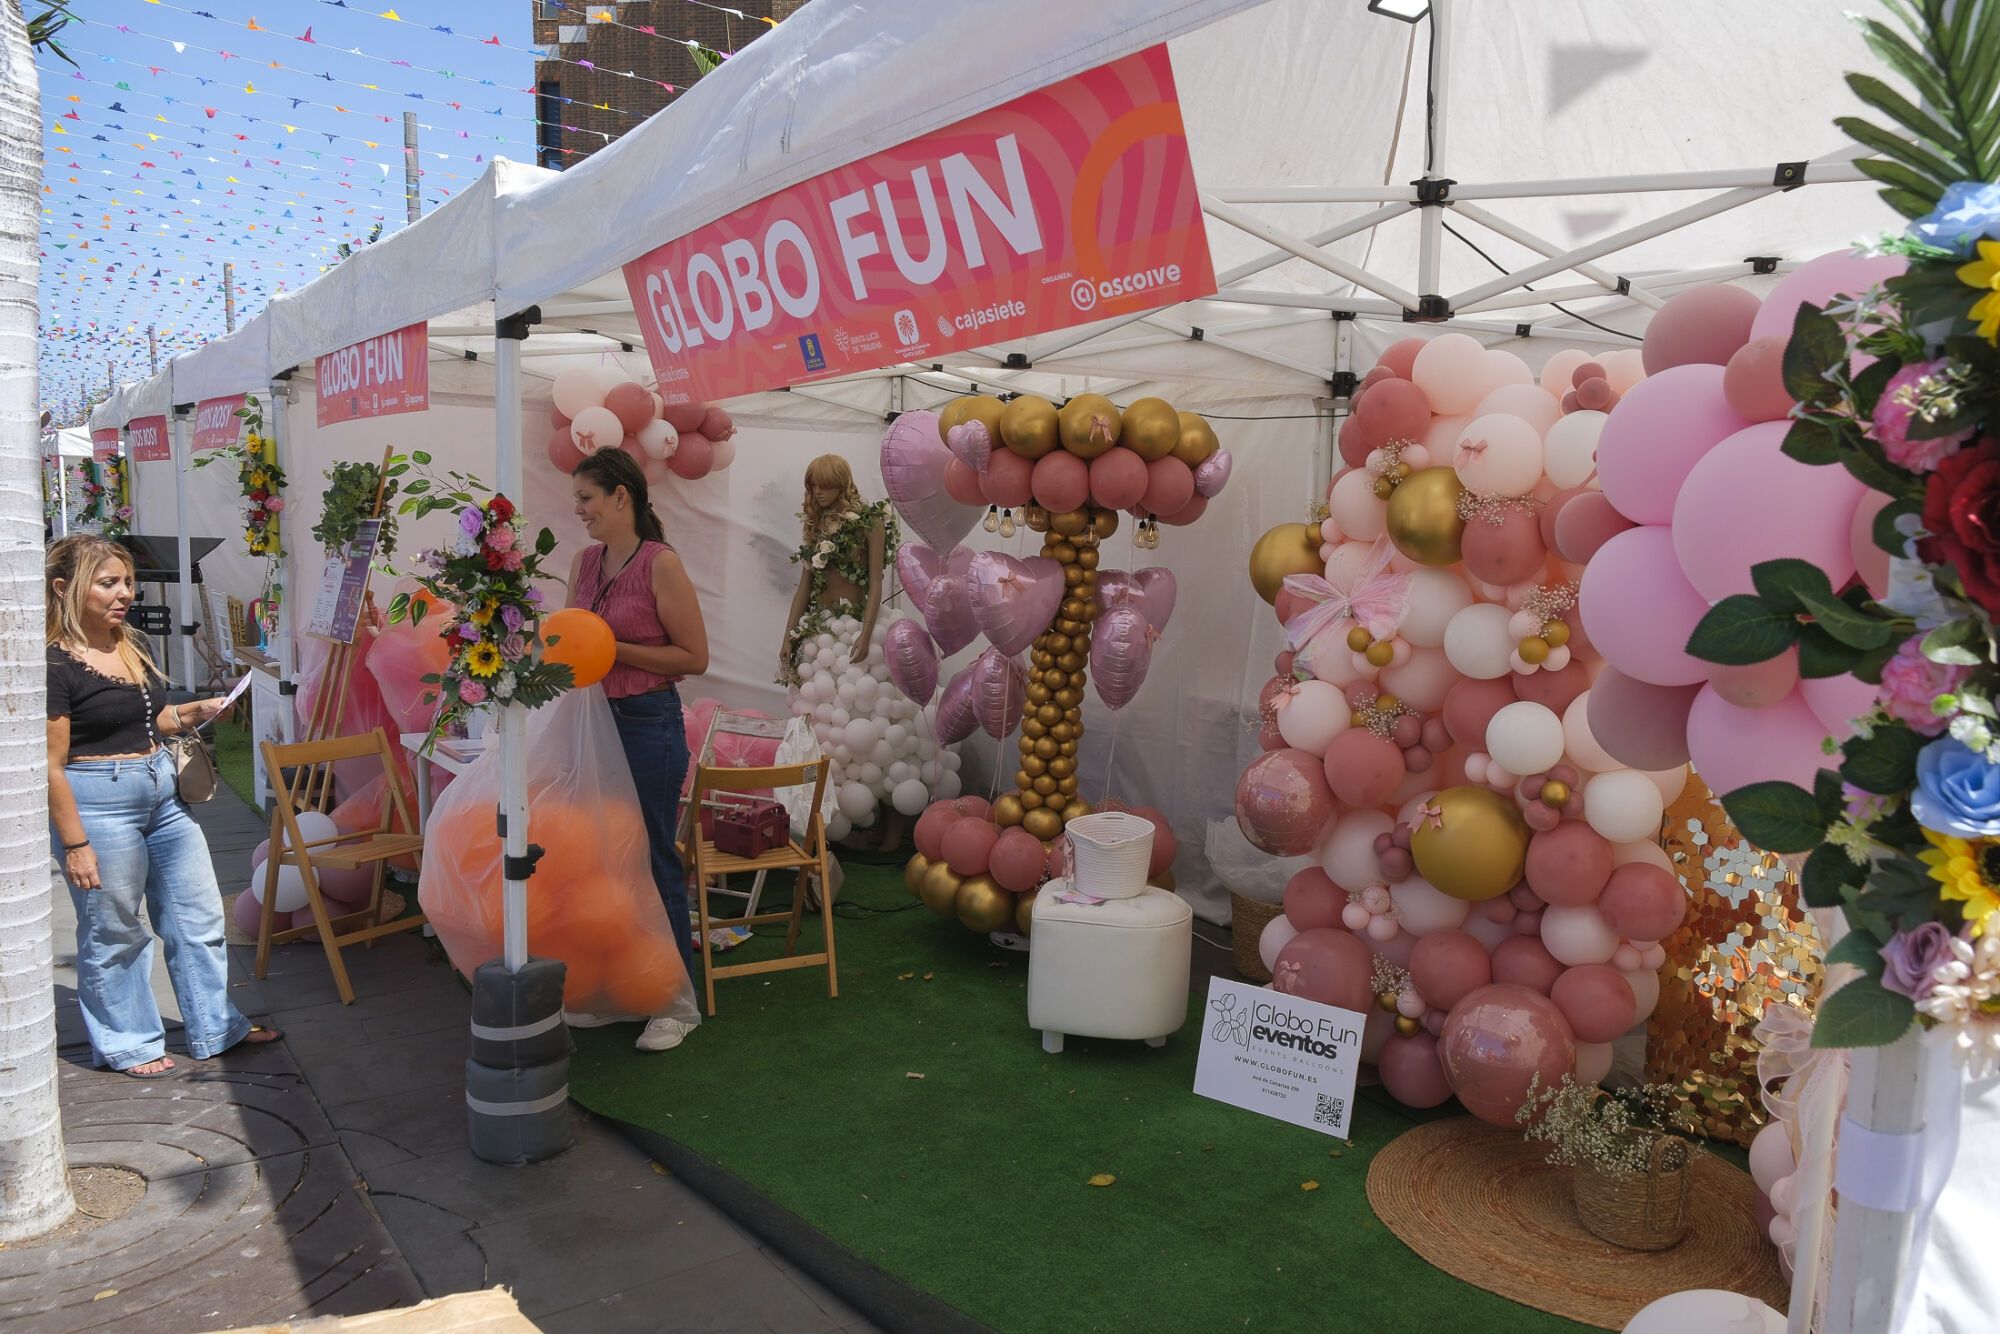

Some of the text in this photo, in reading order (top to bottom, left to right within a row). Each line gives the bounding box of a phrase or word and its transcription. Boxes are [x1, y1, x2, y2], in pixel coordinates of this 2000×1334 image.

[646, 134, 1042, 354] GLOBO FUN
[955, 299, 1026, 331] cajasiete
[321, 332, 403, 398] GLOBO FUN
[143, 427, 157, 447] ROSY
[1255, 1003, 1358, 1047] Globo Fun
[1253, 1025, 1337, 1060] eventos
[1234, 1055, 1318, 1084] WWW.GLOBOFUN.ES
[1252, 1045, 1345, 1075] EVENTS BALLOONS
[1269, 1079, 1290, 1090] Canarias
